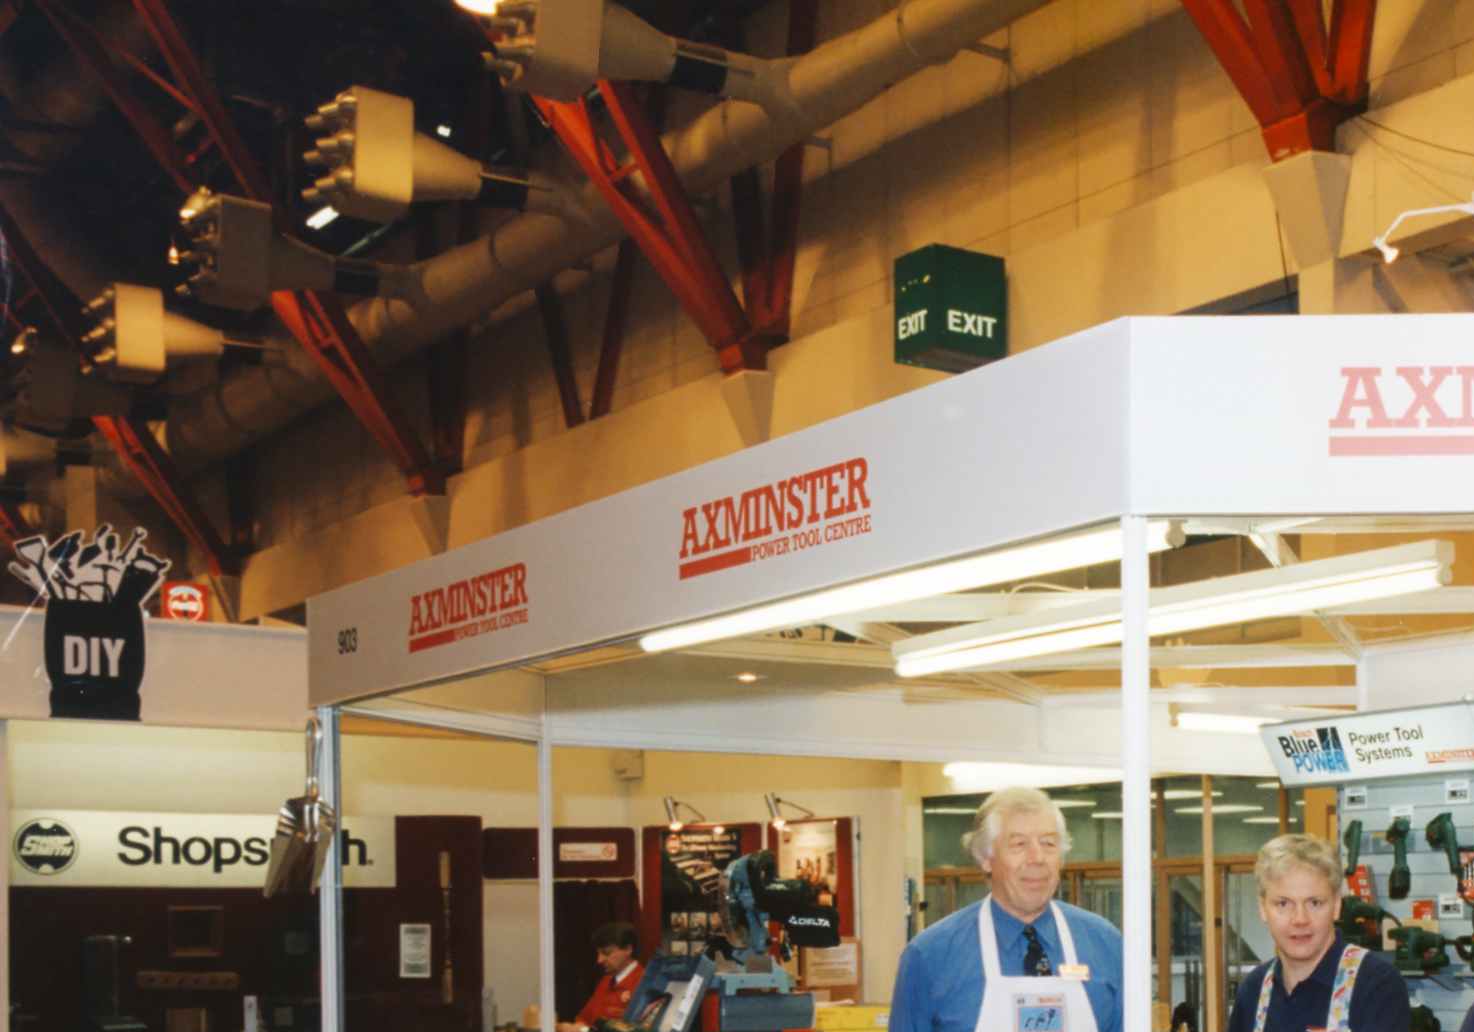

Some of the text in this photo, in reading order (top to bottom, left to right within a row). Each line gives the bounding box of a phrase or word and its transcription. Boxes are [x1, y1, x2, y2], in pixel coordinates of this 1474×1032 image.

[899, 309, 928, 340] EXIT
[947, 309, 997, 338] EXIT
[679, 457, 871, 560] AXMINSTER
[751, 514, 872, 562] POWER TOOL CENTRE
[409, 562, 528, 636] AXMINSTER
[454, 622, 479, 640] POWER
[500, 608, 529, 629] CENTRE
[64, 635, 125, 677] DIY
[338, 627, 358, 655] 903
[1348, 725, 1424, 746] Power Tool
[1292, 750, 1349, 773] POWER
[1355, 746, 1412, 764] Systems
[117, 826, 367, 873] Shopsh
[798, 918, 831, 928] DELTA
